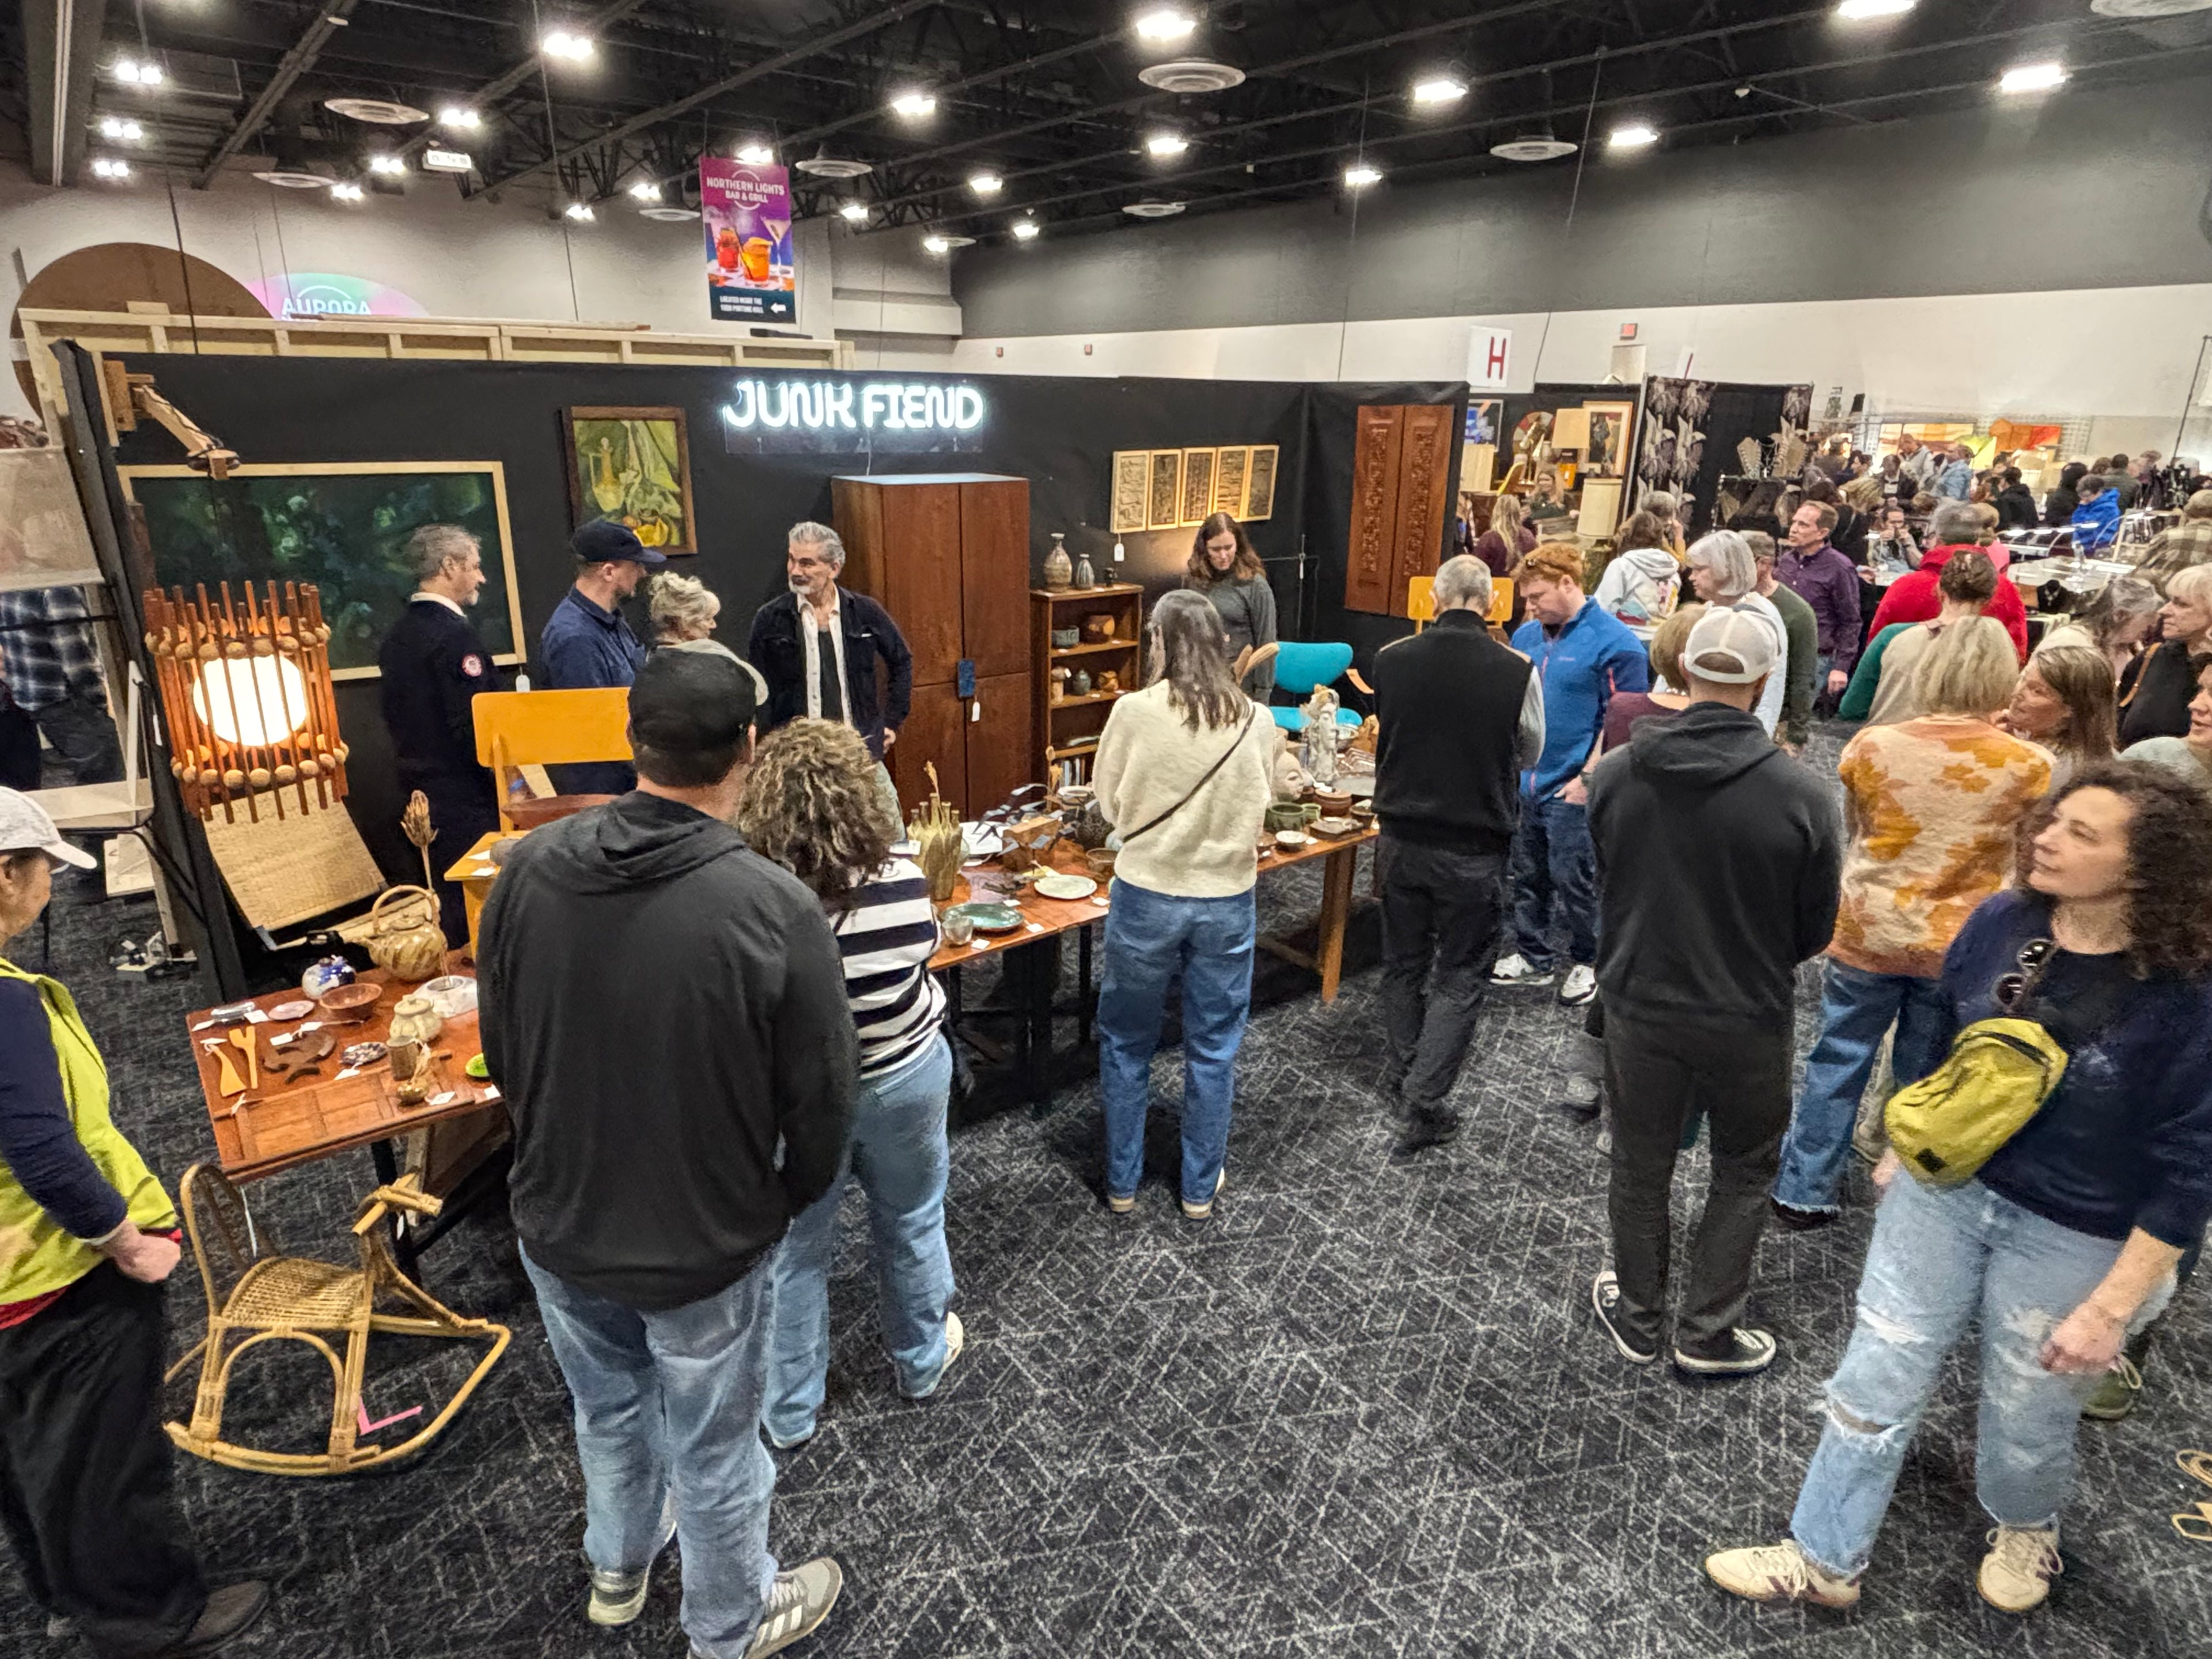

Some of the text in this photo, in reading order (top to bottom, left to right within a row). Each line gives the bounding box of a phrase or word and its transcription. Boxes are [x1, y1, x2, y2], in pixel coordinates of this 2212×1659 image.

[707, 176, 785, 196] NORTHERN LIGHTS
[725, 190, 768, 203] BAR & GRILL
[1487, 336, 1506, 380] H
[724, 380, 984, 429] JUNK FIEND
